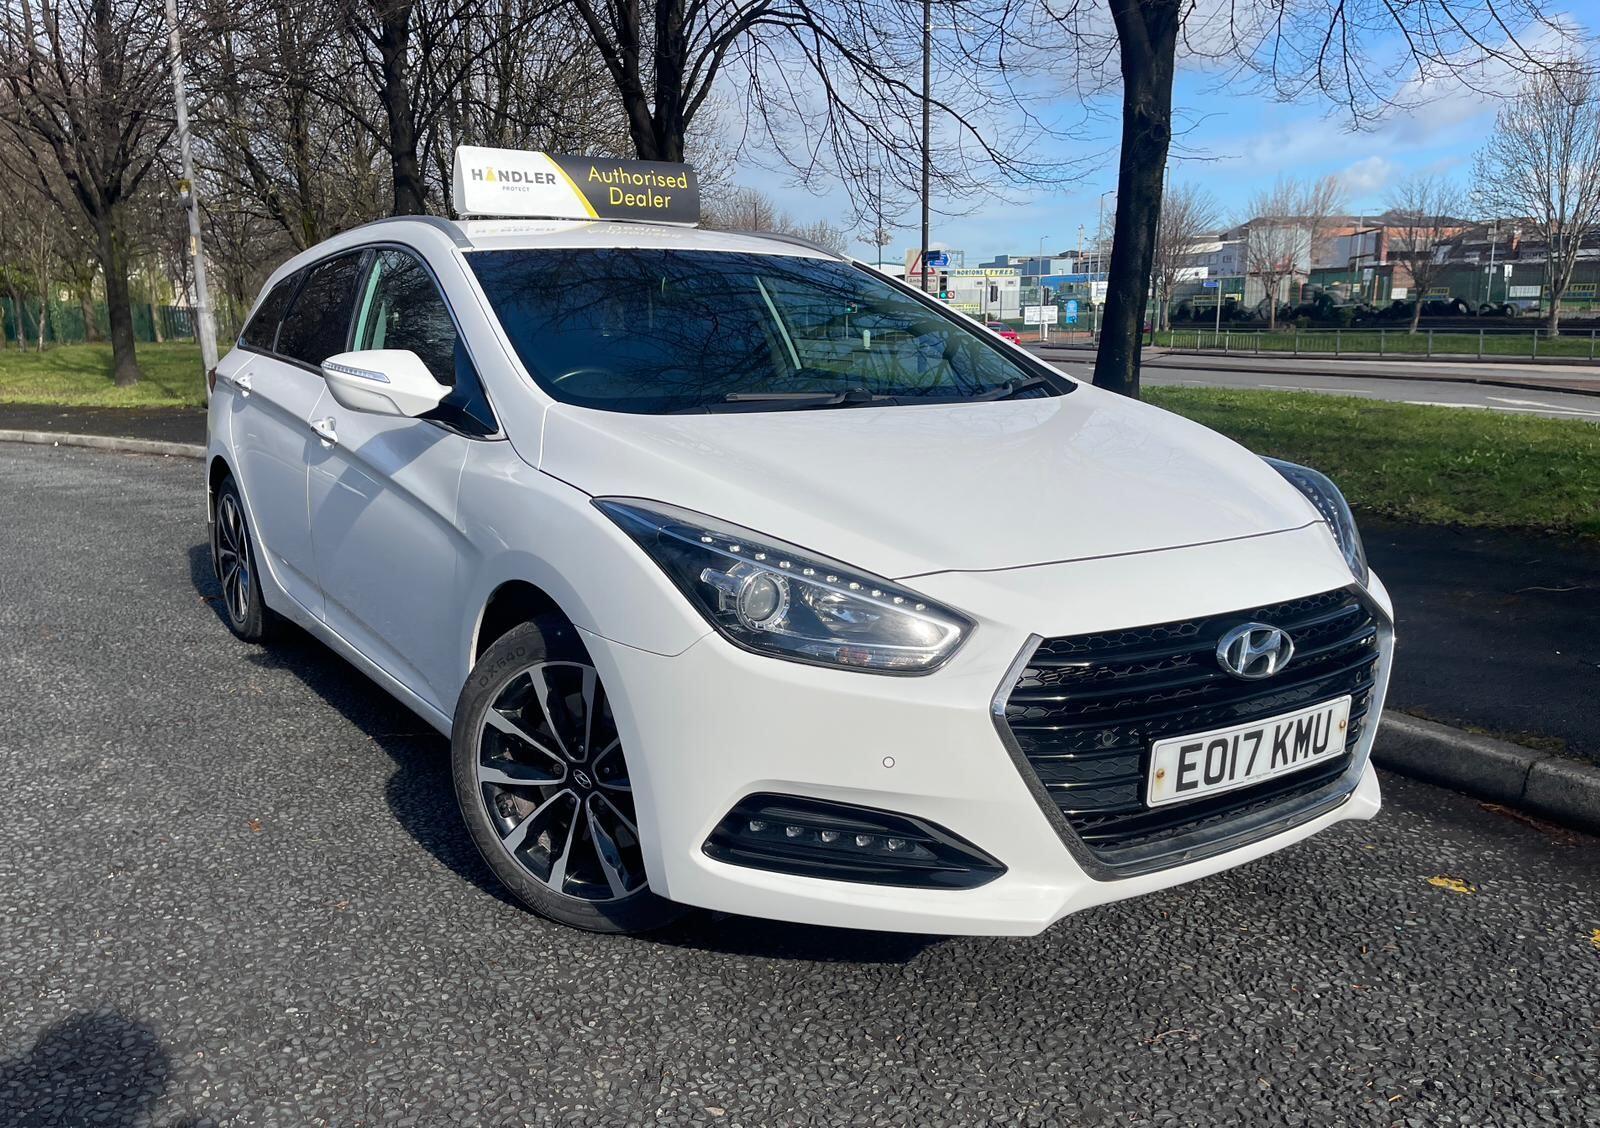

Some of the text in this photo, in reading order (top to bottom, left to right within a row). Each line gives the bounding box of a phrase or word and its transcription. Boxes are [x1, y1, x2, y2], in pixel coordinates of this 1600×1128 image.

[471, 167, 556, 185] HANDLER
[588, 165, 688, 189] Authorised
[609, 187, 671, 208] Dealer
[1271, 710, 1333, 770] KMU
